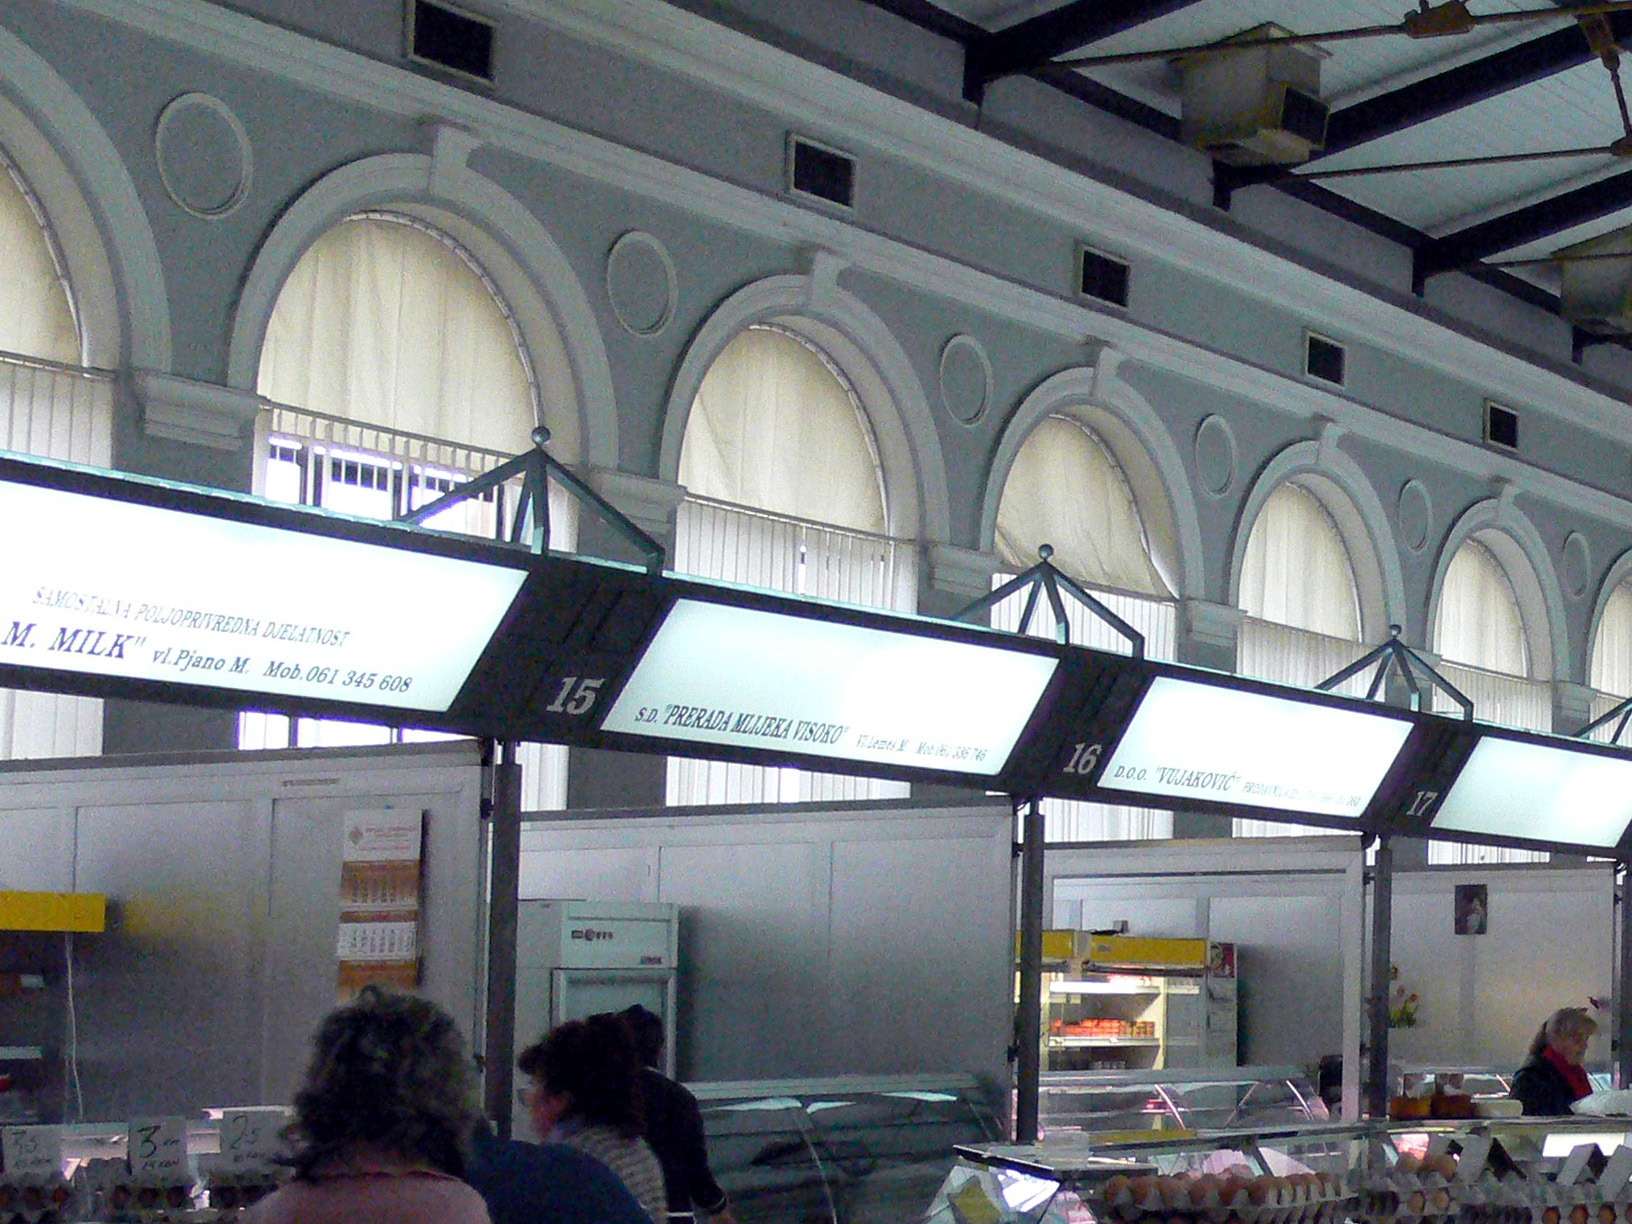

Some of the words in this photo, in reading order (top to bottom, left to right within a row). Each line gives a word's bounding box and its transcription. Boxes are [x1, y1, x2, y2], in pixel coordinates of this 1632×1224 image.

[135, 603, 259, 638] POLJOPRIVREDNA
[262, 622, 351, 648] DJELATNOST
[49, 626, 146, 659] MILK"
[262, 660, 338, 685] Mob.061
[342, 670, 376, 691] 345
[379, 675, 413, 693] 608
[546, 676, 605, 716] 15
[634, 706, 658, 724] S.D.
[663, 703, 734, 732] "PRERADA
[731, 712, 793, 739] MLIJEKA
[792, 719, 850, 745] VISOKO"
[1063, 742, 1101, 775] 16
[1112, 765, 1147, 783] D.O.O.
[1405, 790, 1438, 817] 17
